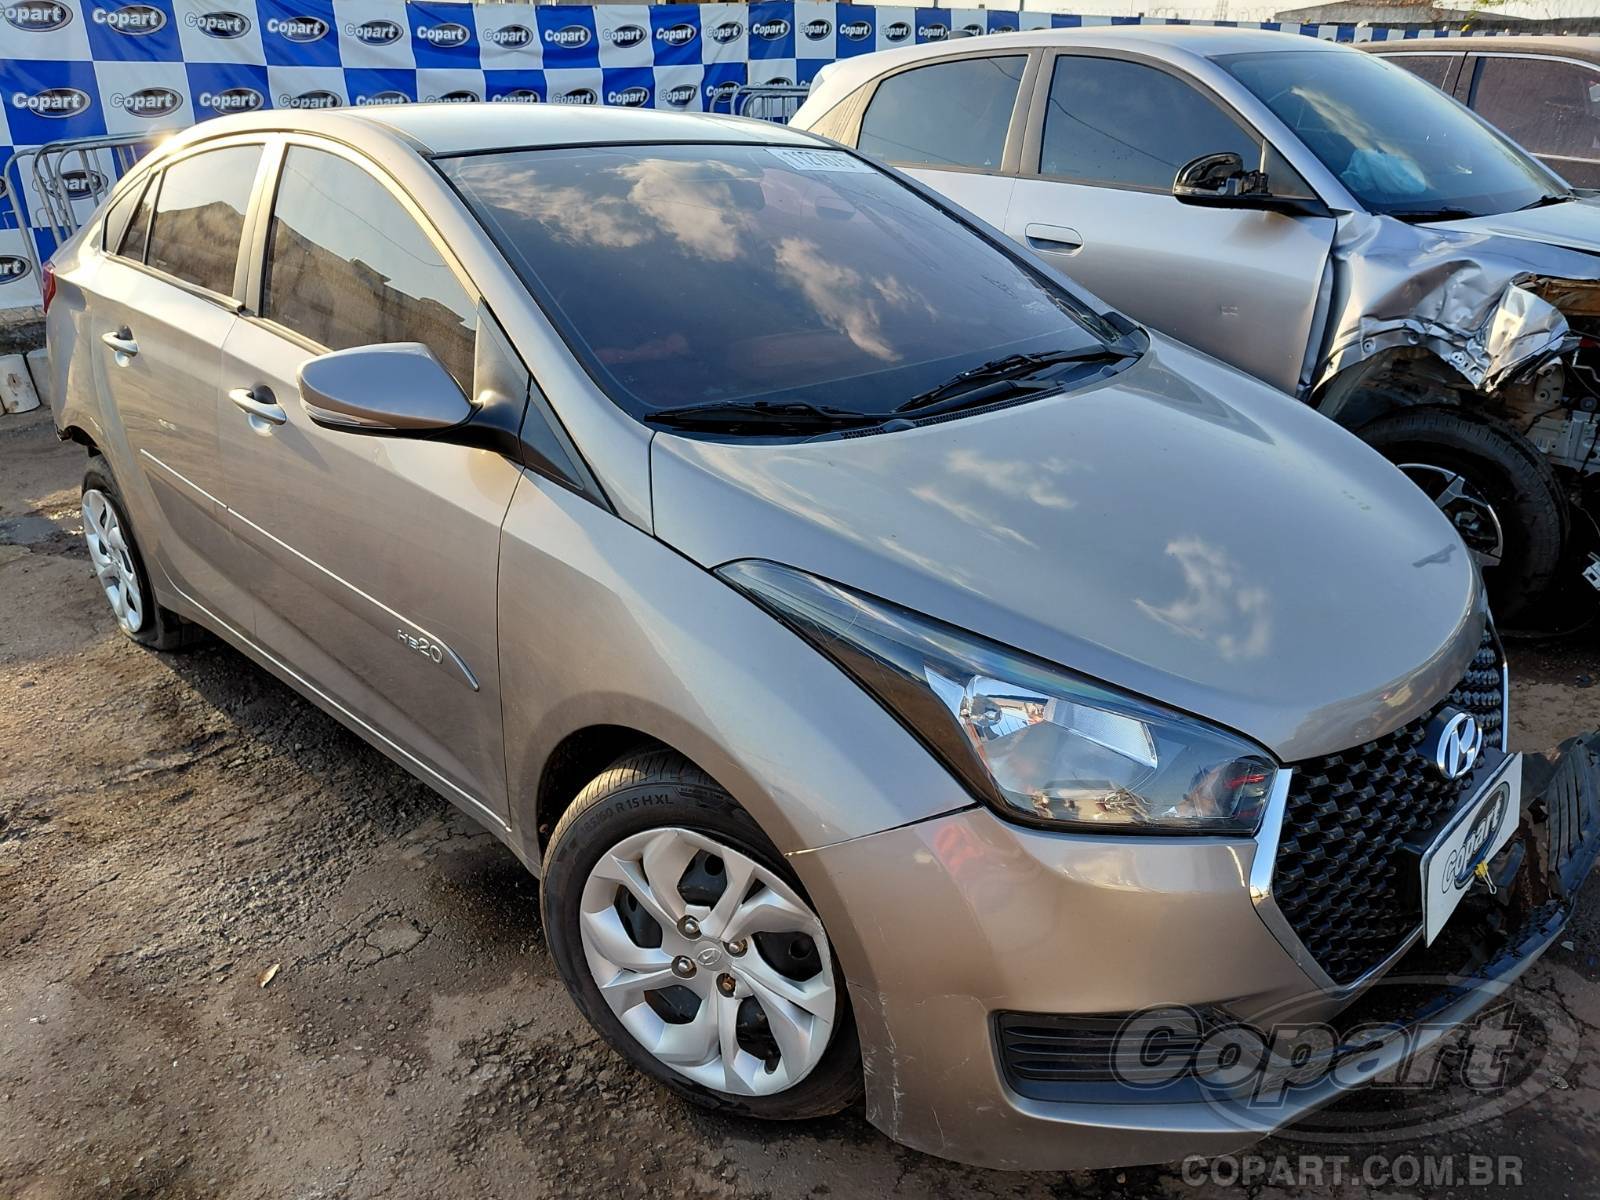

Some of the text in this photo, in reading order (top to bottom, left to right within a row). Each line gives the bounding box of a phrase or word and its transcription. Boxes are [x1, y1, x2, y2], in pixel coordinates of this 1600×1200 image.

[0, 5, 61, 24] opart
[92, 9, 158, 26] Copart
[185, 12, 242, 32] Copart
[267, 18, 321, 35] Copart
[345, 23, 396, 40] Copart
[417, 26, 464, 42] Copart
[656, 26, 694, 43] Copart
[707, 24, 741, 39] Copart
[752, 20, 787, 36] Copart
[800, 21, 829, 37] Copart
[839, 23, 868, 38] Copart
[881, 23, 908, 37] Copart
[918, 26, 945, 37] Copart
[484, 28, 528, 44] Copart
[544, 29, 586, 45] Copart
[603, 28, 642, 43] Copart
[13, 92, 80, 111] Copart
[110, 92, 175, 111] Copart
[199, 91, 256, 109] Copart
[279, 94, 335, 109] Copart
[552, 93, 592, 105] Copart
[608, 90, 646, 107] Copart
[660, 87, 695, 104] Copart
[397, 629, 443, 664] HB20
[1442, 794, 1503, 894] Copart
